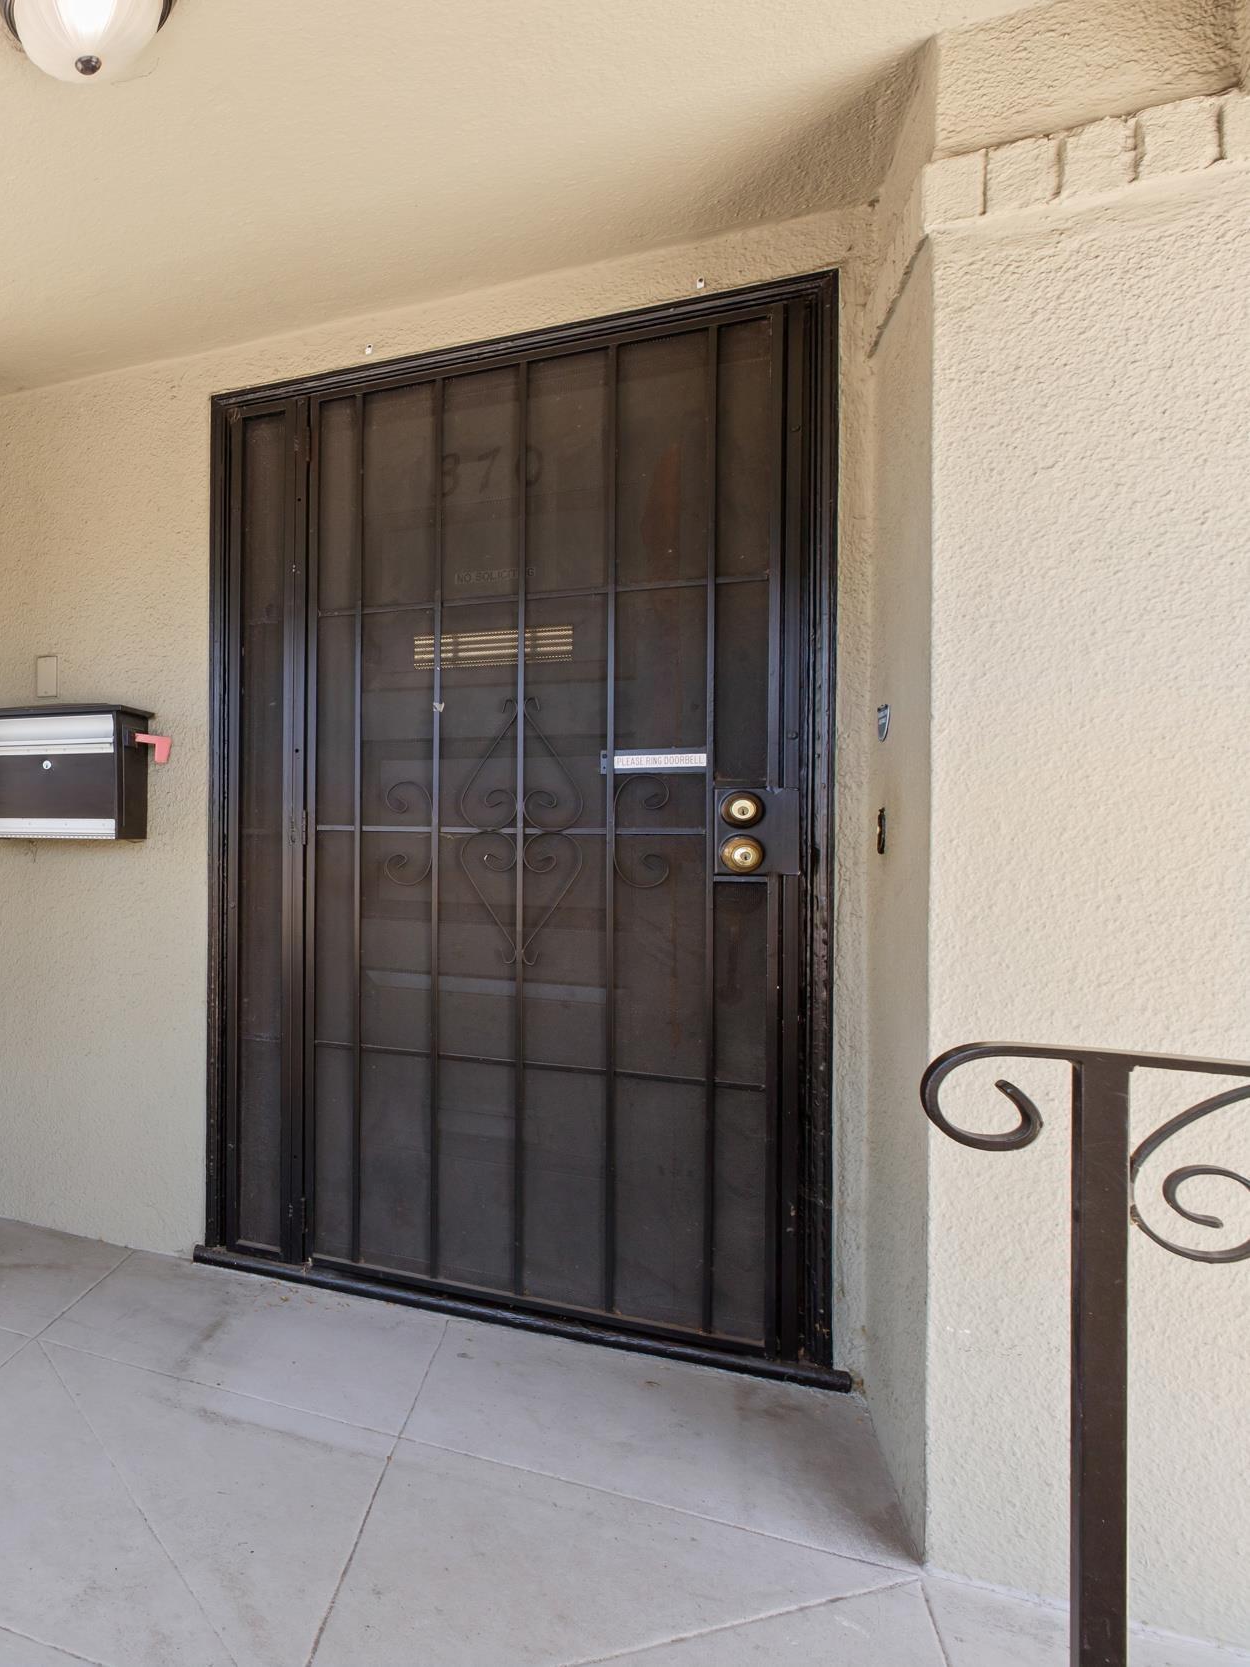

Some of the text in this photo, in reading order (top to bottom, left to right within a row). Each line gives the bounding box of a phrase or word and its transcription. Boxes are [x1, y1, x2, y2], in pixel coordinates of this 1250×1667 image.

[475, 568, 535, 581] SOLICITG
[616, 757, 643, 766] PLEASE
[646, 756, 662, 765] RING
